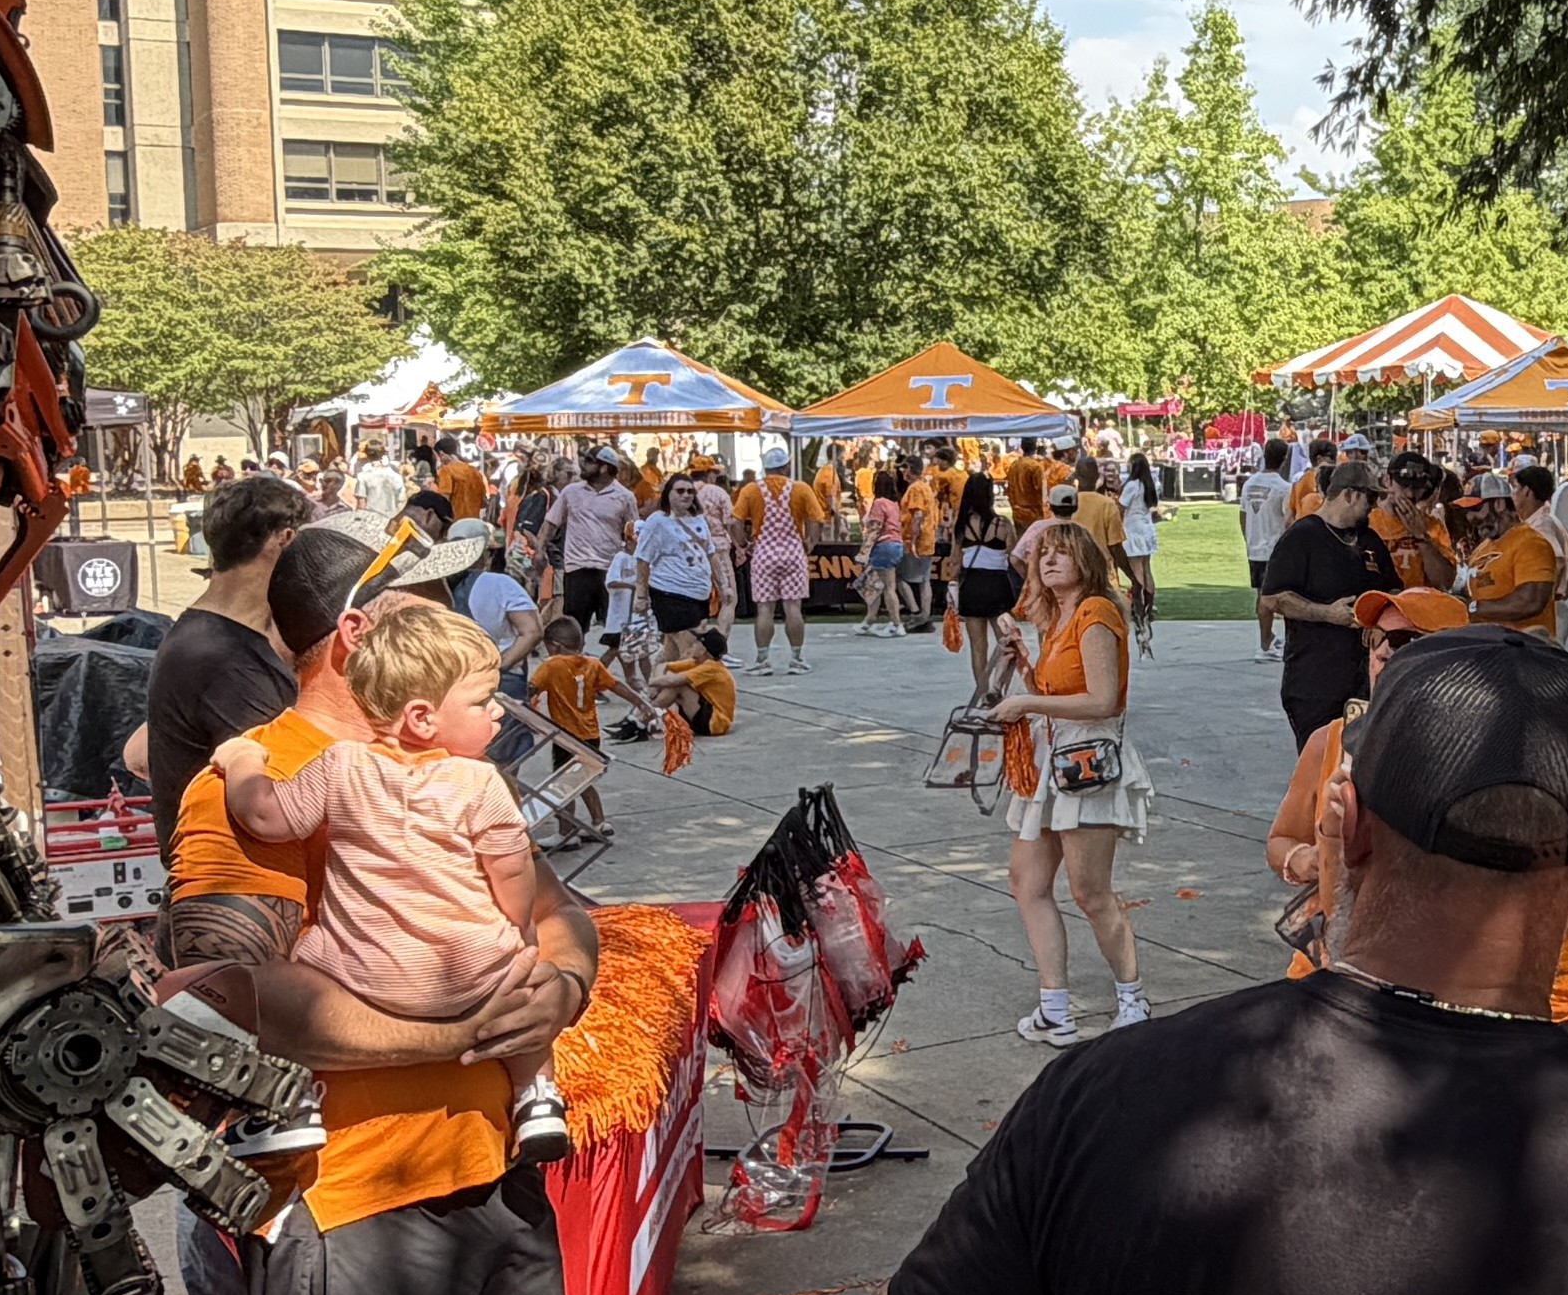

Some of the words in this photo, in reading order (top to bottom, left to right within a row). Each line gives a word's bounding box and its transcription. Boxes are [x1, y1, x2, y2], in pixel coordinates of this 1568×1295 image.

[607, 373, 673, 405] T
[909, 373, 974, 409] T
[575, 674, 585, 708] 1
